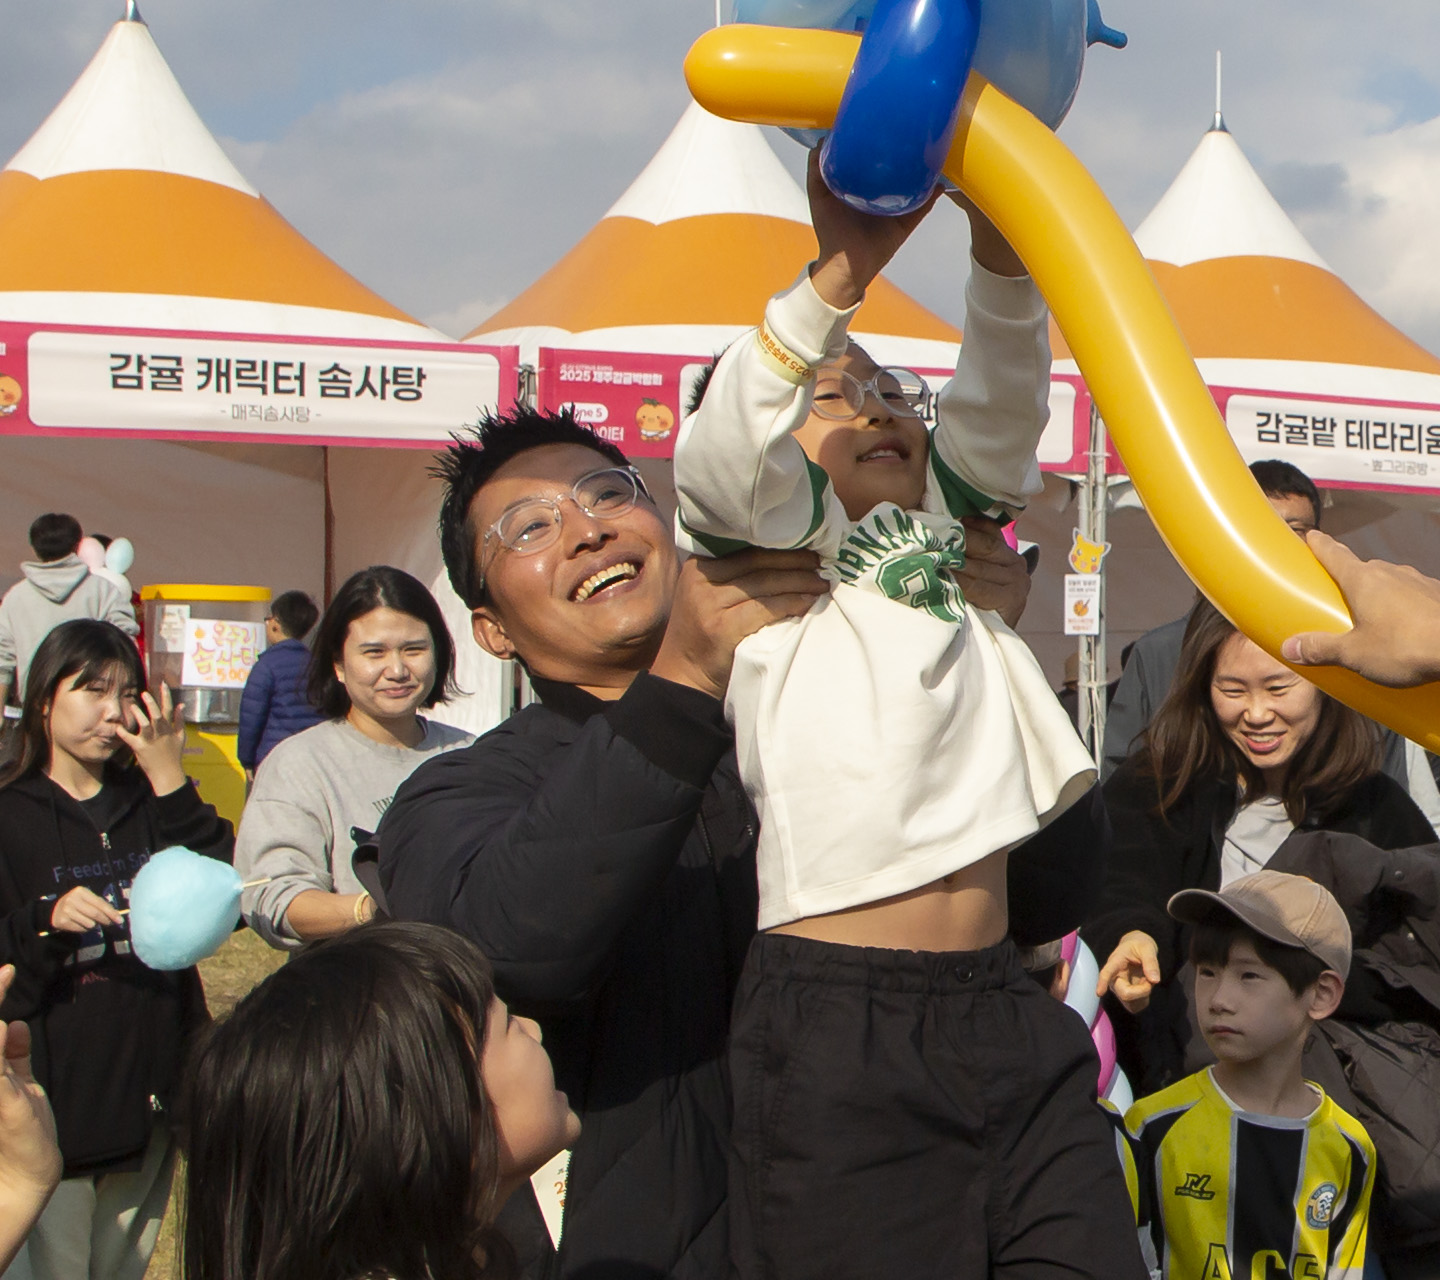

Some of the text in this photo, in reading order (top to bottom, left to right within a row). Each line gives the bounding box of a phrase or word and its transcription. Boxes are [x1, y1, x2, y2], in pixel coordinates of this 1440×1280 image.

[110, 353, 427, 402] 감귤 캐릭터 솜사탕
[560, 370, 591, 382] 2025
[231, 404, 311, 423] 매직솜사탕
[596, 408, 602, 418] 5
[1256, 411, 1337, 448] 감귤밭
